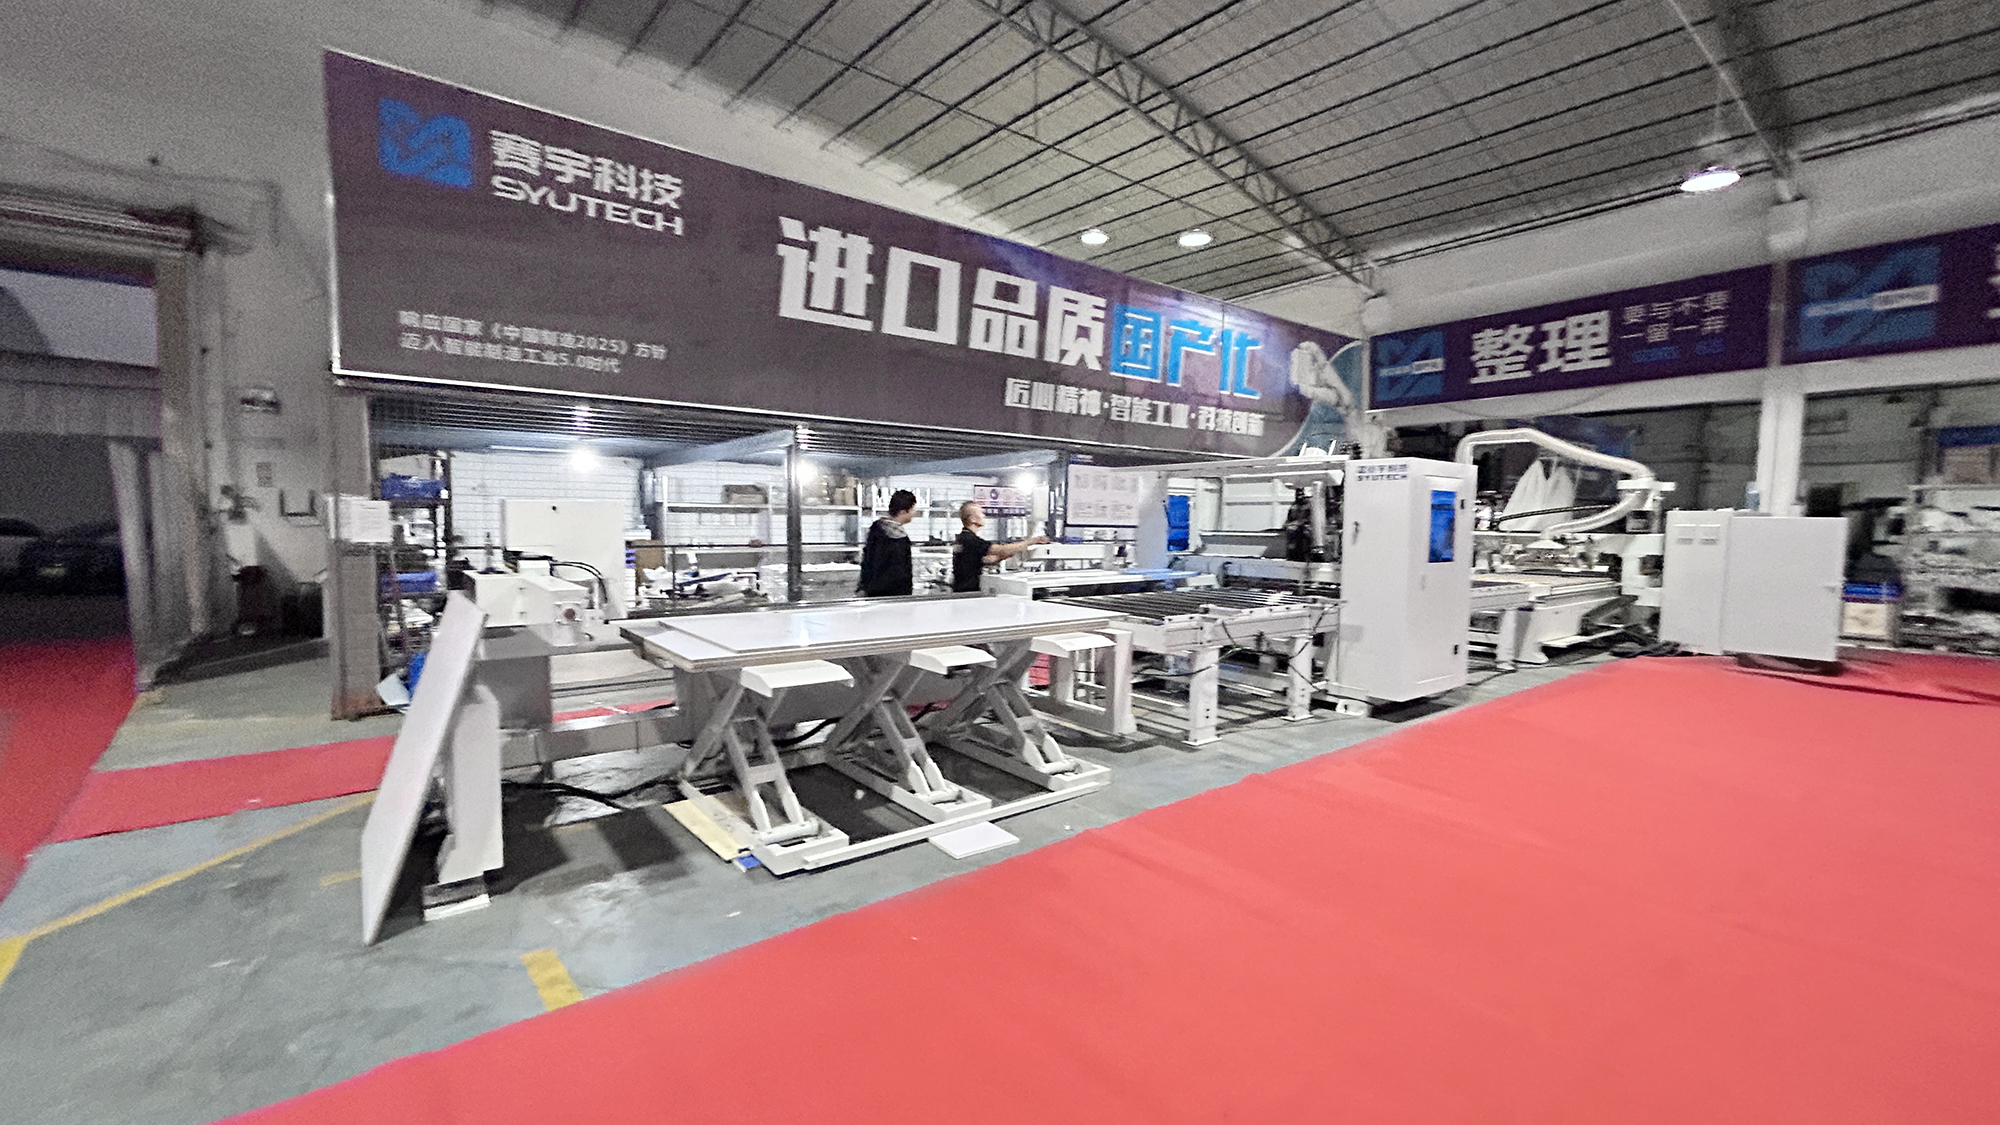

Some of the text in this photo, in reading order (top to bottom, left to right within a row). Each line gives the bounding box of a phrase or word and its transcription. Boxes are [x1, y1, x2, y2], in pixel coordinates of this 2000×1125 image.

[489, 130, 683, 209] 赛宇科技
[490, 175, 685, 236] SYUTECH
[777, 216, 1262, 399] 进口品质国产化
[1470, 310, 1613, 384] 整理
